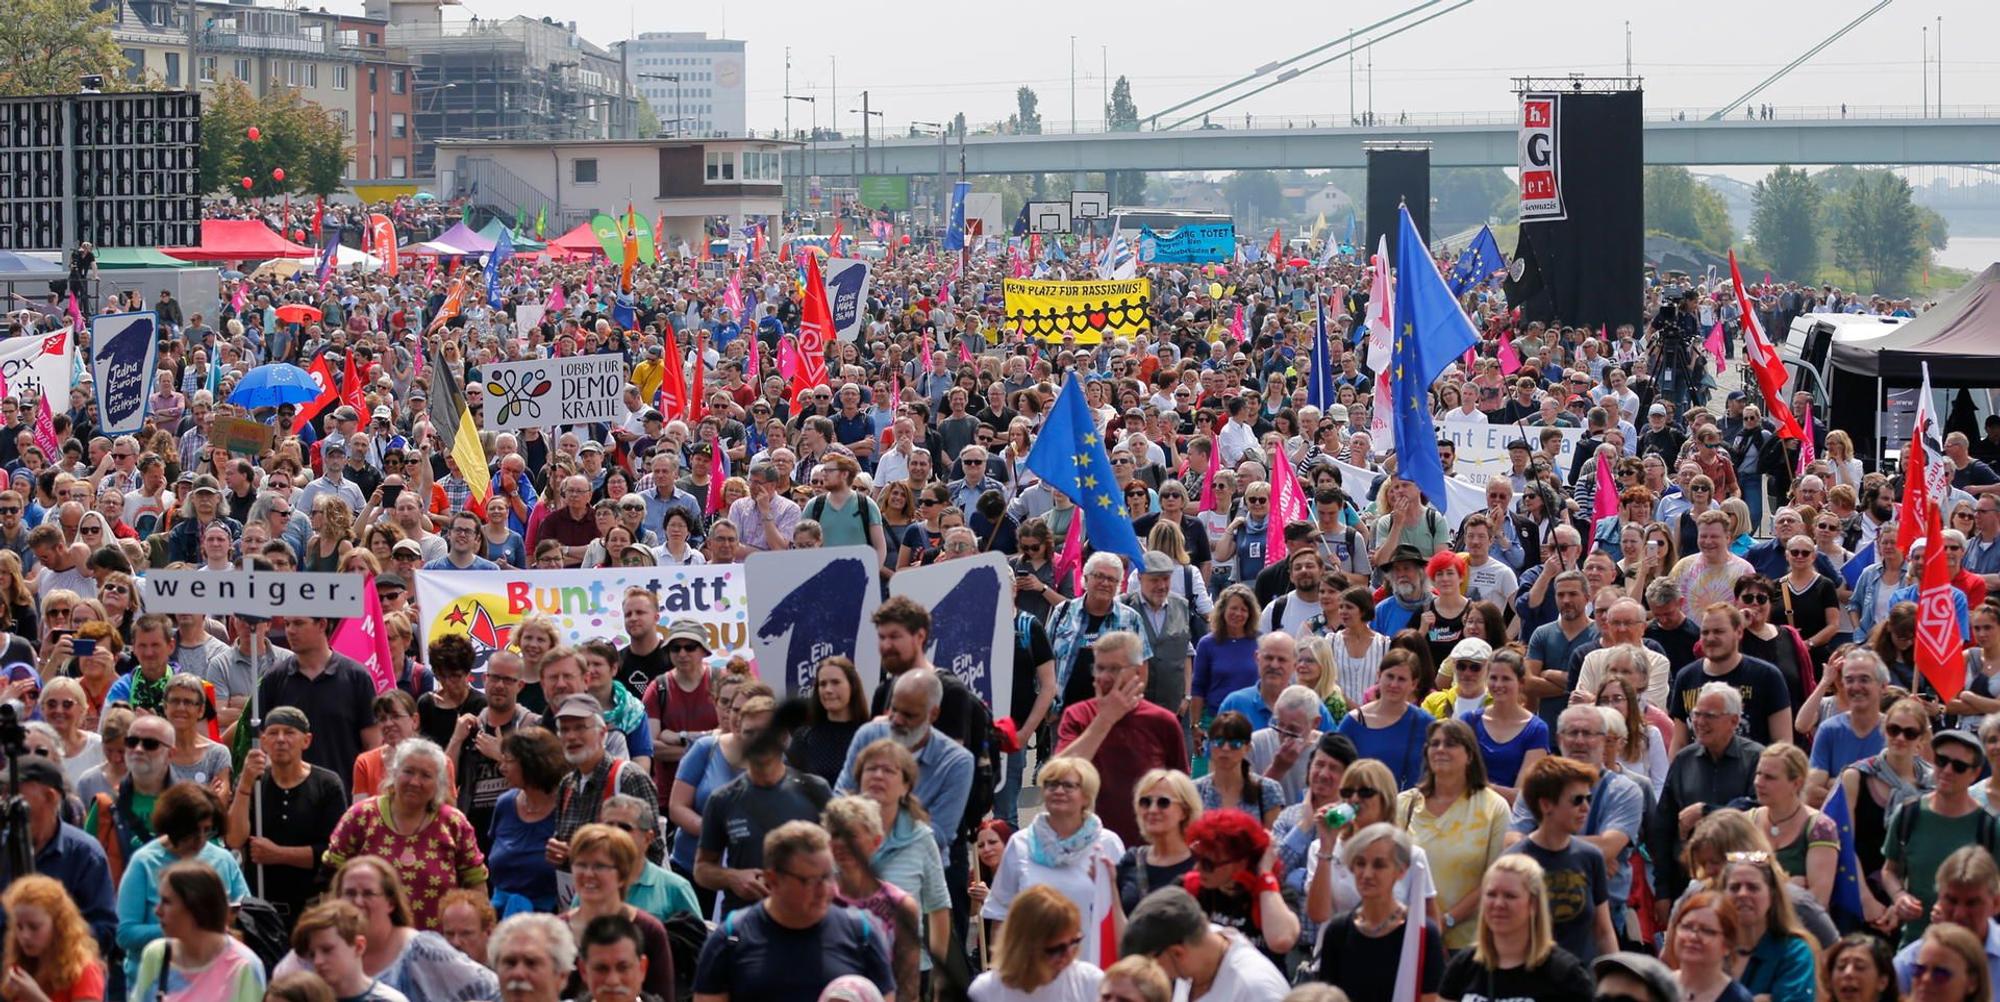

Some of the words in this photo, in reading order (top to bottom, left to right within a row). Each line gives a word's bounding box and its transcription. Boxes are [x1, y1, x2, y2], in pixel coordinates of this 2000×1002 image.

[1527, 133, 1552, 166] G
[1528, 176, 1552, 193] er!
[1006, 283, 1025, 295] KEIN
[1028, 286, 1057, 296] PLATZ
[1082, 282, 1142, 296] RASSISMUS!
[561, 362, 596, 377] LOBBY
[561, 374, 619, 401] DEMO
[561, 399, 620, 420] KRATIE
[154, 574, 356, 606] weniger.
[506, 580, 608, 615] Bunt
[641, 577, 731, 612] tatt
[811, 642, 833, 663] Ein
[953, 653, 973, 675] Ein
